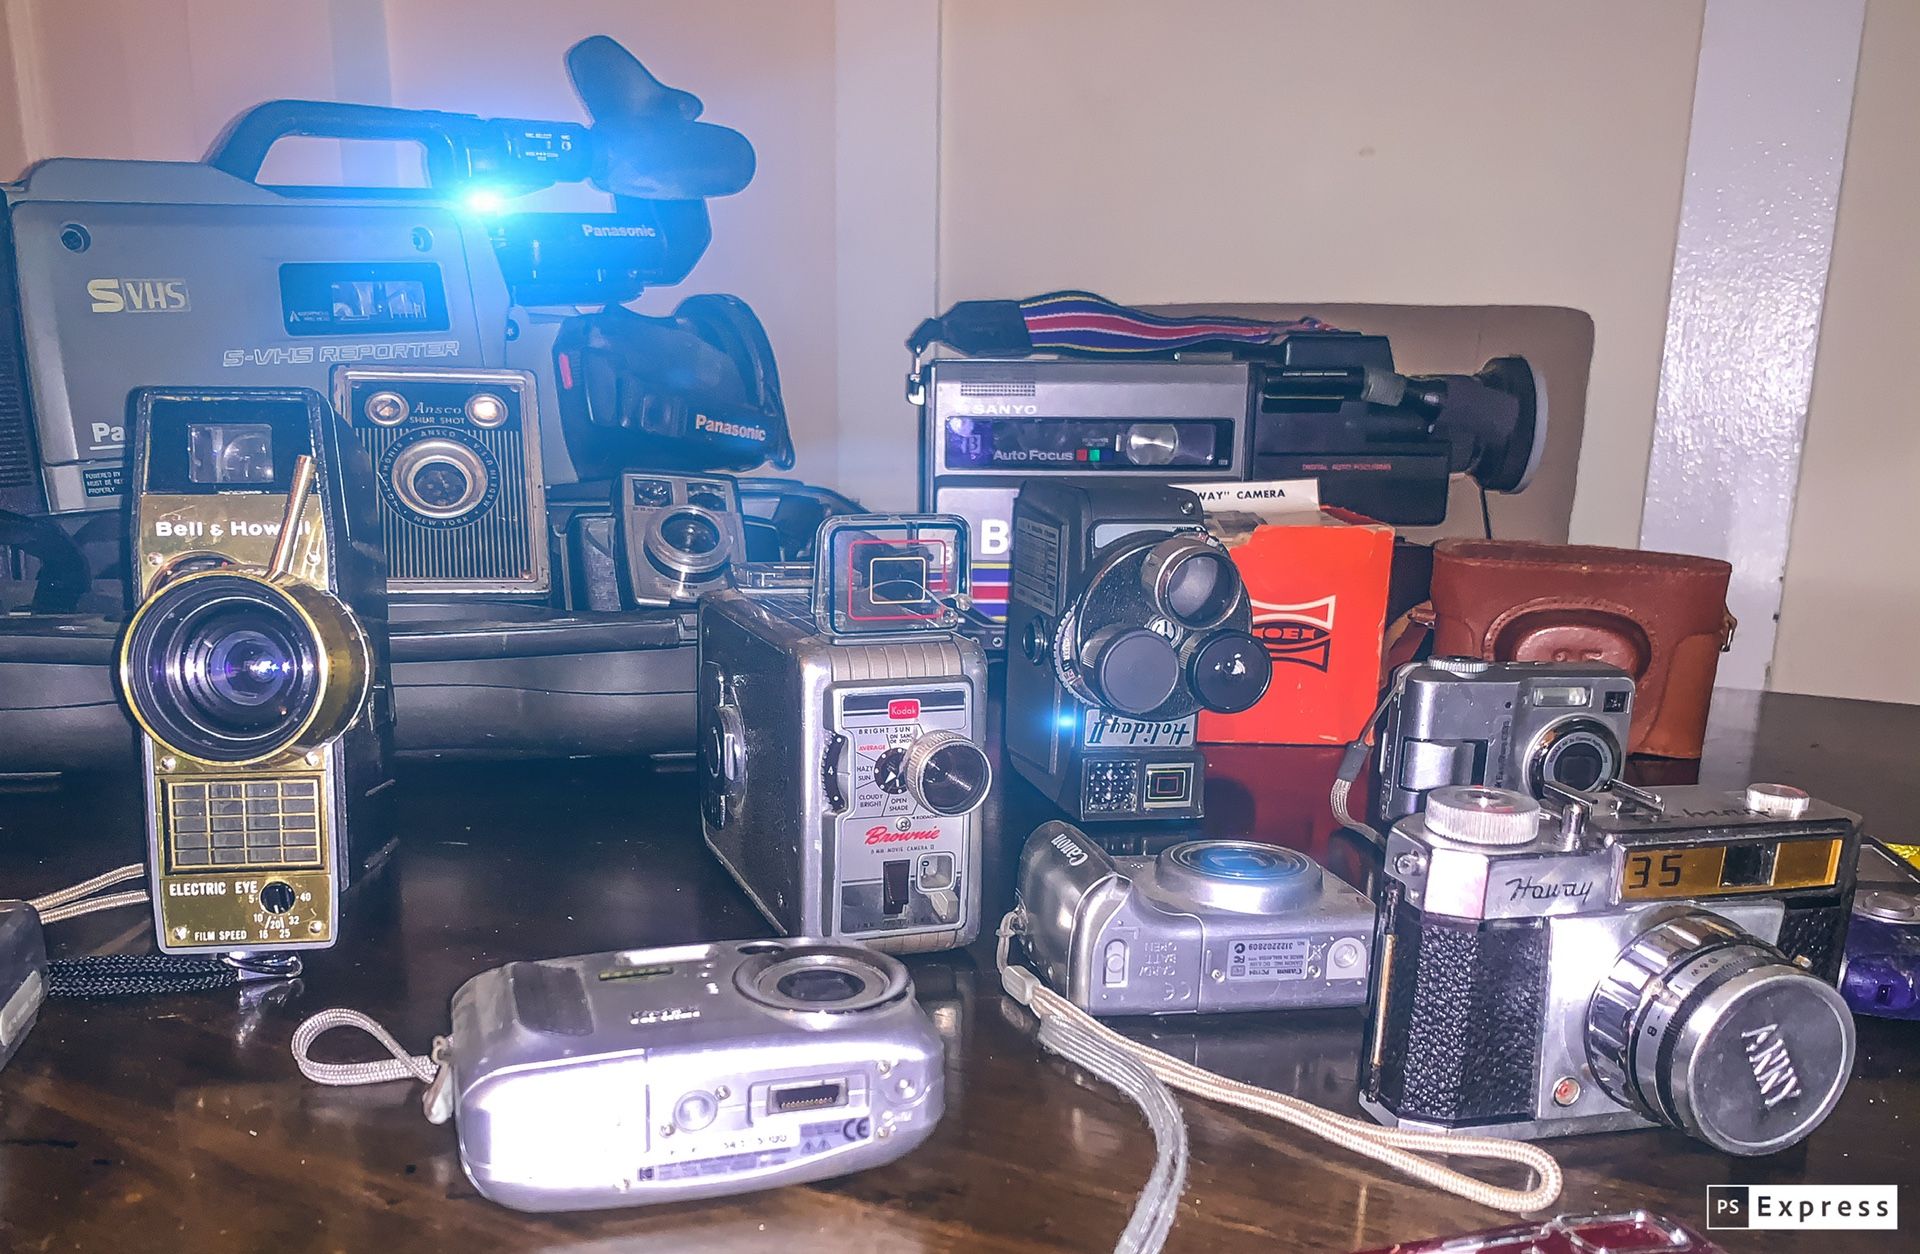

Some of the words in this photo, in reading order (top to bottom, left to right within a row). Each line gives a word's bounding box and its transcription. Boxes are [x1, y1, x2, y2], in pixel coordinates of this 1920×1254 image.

[582, 223, 656, 237] Panasonic
[222, 346, 314, 367] S-VHS
[319, 341, 460, 363] REPORTER
[414, 402, 462, 415] Ansco
[972, 404, 1037, 415] SANYO
[409, 416, 436, 425] SHUR
[440, 417, 465, 425] SHOT
[420, 430, 457, 438] ANSCO
[695, 414, 767, 442] Panasonic
[993, 449, 1027, 461] Auto
[1030, 449, 1073, 461] Focus
[1237, 488, 1286, 499] CAMERA
[413, 515, 437, 526] NEW
[442, 516, 470, 527] YORK
[155, 521, 203, 537] Bell
[210, 522, 224, 537] &
[230, 520, 311, 537] Howll
[891, 704, 917, 716] Kodak
[858, 727, 889, 735] BRIGHT
[1110, 717, 1189, 745] Holiday
[858, 744, 886, 752] AVERAGE
[827, 766, 834, 776] 4
[857, 765, 874, 773] HAZY
[858, 793, 883, 801] CLOUDY
[889, 804, 909, 812] SHADE
[865, 826, 941, 845] Brownie
[1051, 833, 1089, 866] Canon
[1628, 854, 1683, 890] 35
[169, 881, 227, 897] ELECTRIC
[235, 880, 259, 895] EYE
[248, 894, 255, 904] 5
[299, 891, 312, 902] 40
[253, 914, 264, 923] 10
[270, 918, 281, 929] 20
[288, 915, 300, 925] 32
[194, 931, 215, 942] FILM
[218, 930, 247, 941] SPEED
[279, 927, 291, 939] 25
[1741, 1024, 1801, 1107] ANNY
